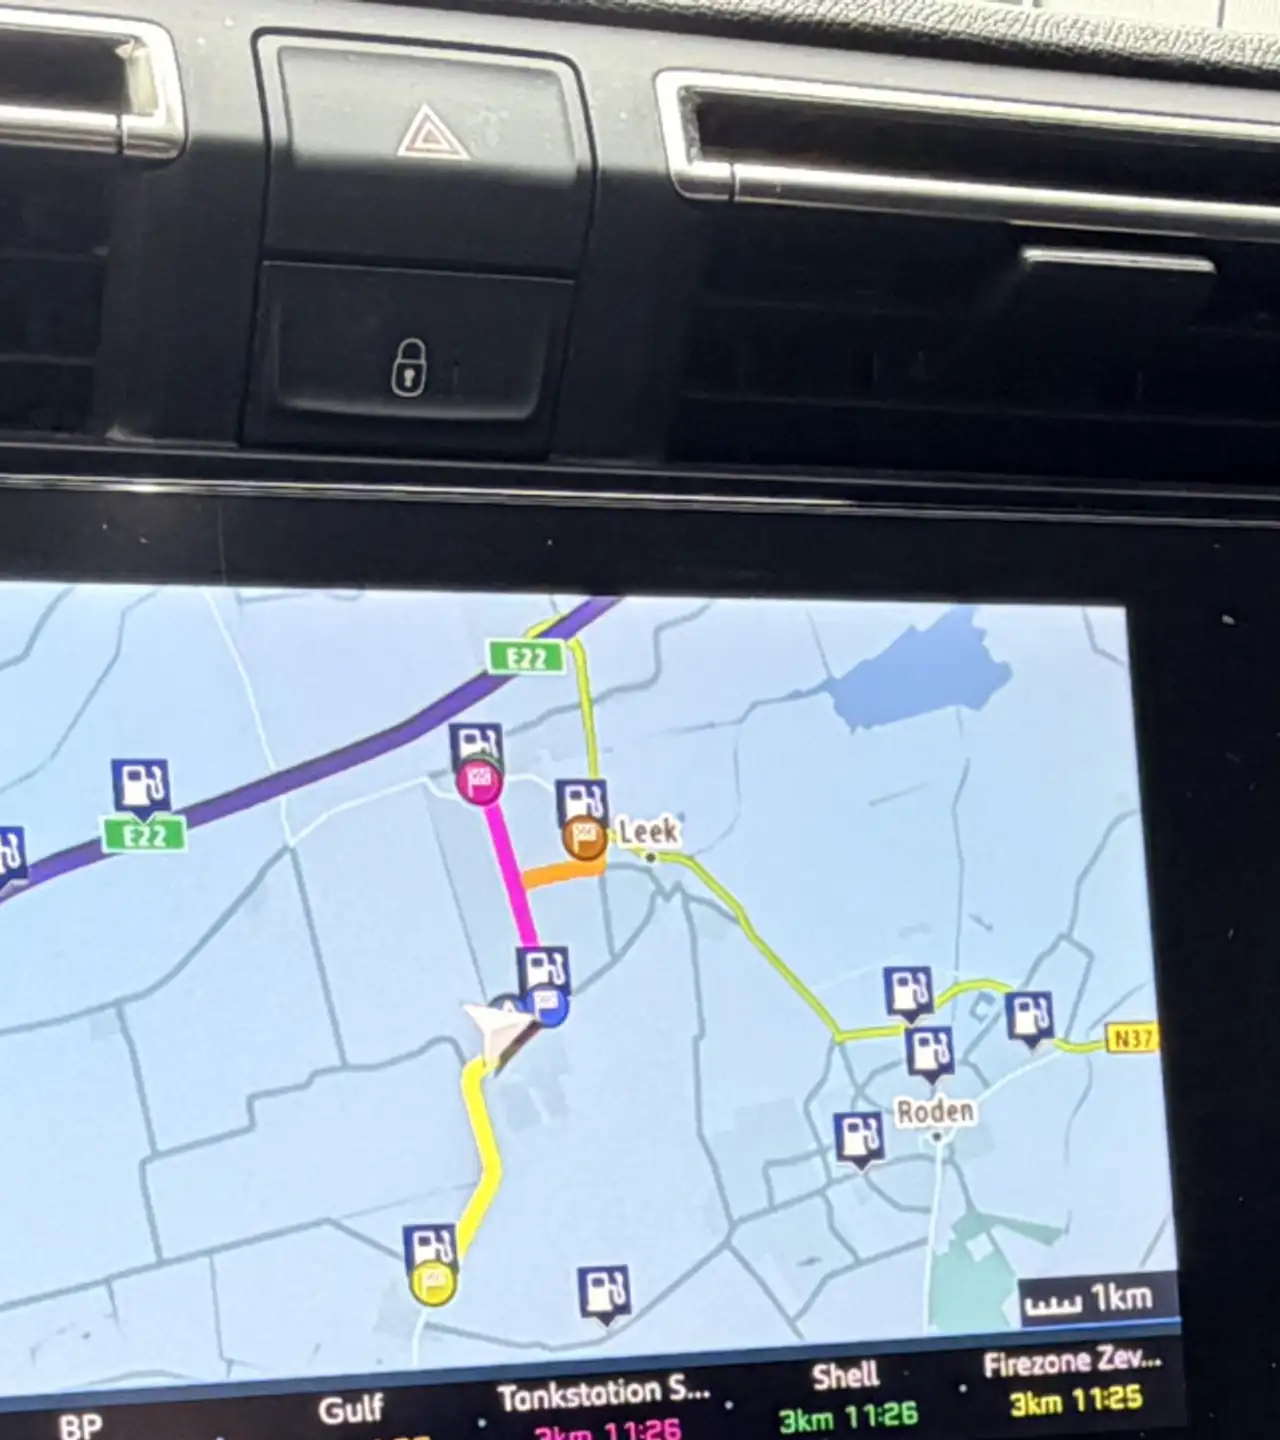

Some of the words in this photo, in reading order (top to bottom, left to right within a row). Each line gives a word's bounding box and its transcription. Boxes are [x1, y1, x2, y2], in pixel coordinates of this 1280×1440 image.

[506, 646, 548, 670] E22
[123, 824, 167, 848] E22
[619, 816, 678, 844] Leek
[898, 1096, 974, 1124] Roden
[1090, 1282, 1153, 1313] 1km
[811, 1359, 881, 1391] Shell
[983, 1350, 1092, 1379] Firezone
[318, 1392, 384, 1425] Gulf
[496, 1378, 663, 1413] Tankstation
[1009, 1390, 1064, 1418] 3km
[1072, 1383, 1144, 1413] 11:25
[778, 1407, 834, 1434] 3km
[845, 1400, 919, 1429] 11:26
